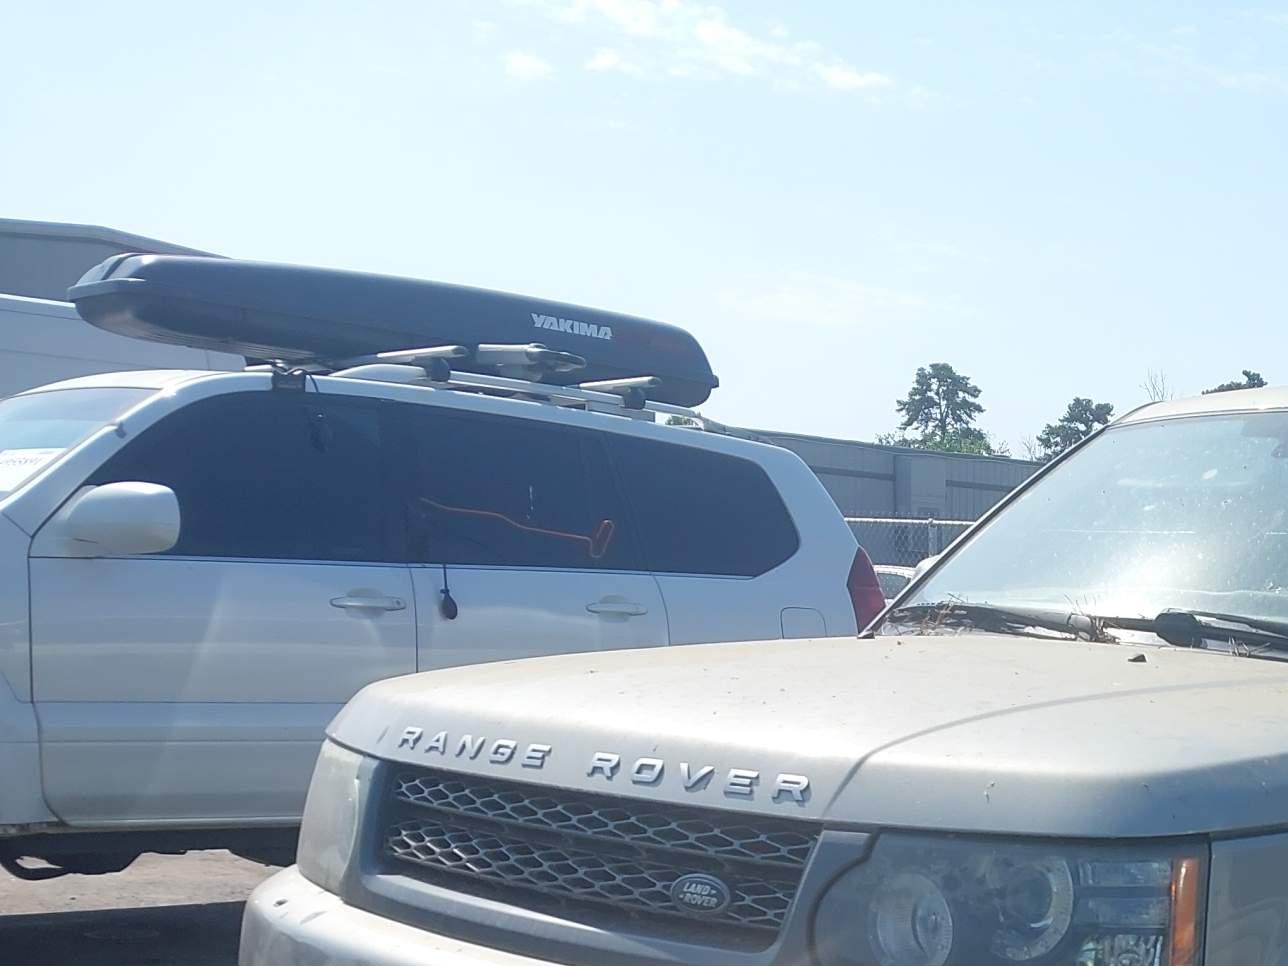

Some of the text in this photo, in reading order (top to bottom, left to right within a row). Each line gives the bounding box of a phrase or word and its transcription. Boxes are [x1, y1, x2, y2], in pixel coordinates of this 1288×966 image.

[530, 312, 613, 340] YAKIMA
[397, 725, 812, 806] RANGE ROVER
[683, 882, 711, 895] LAND
[683, 893, 718, 908] ROVER
